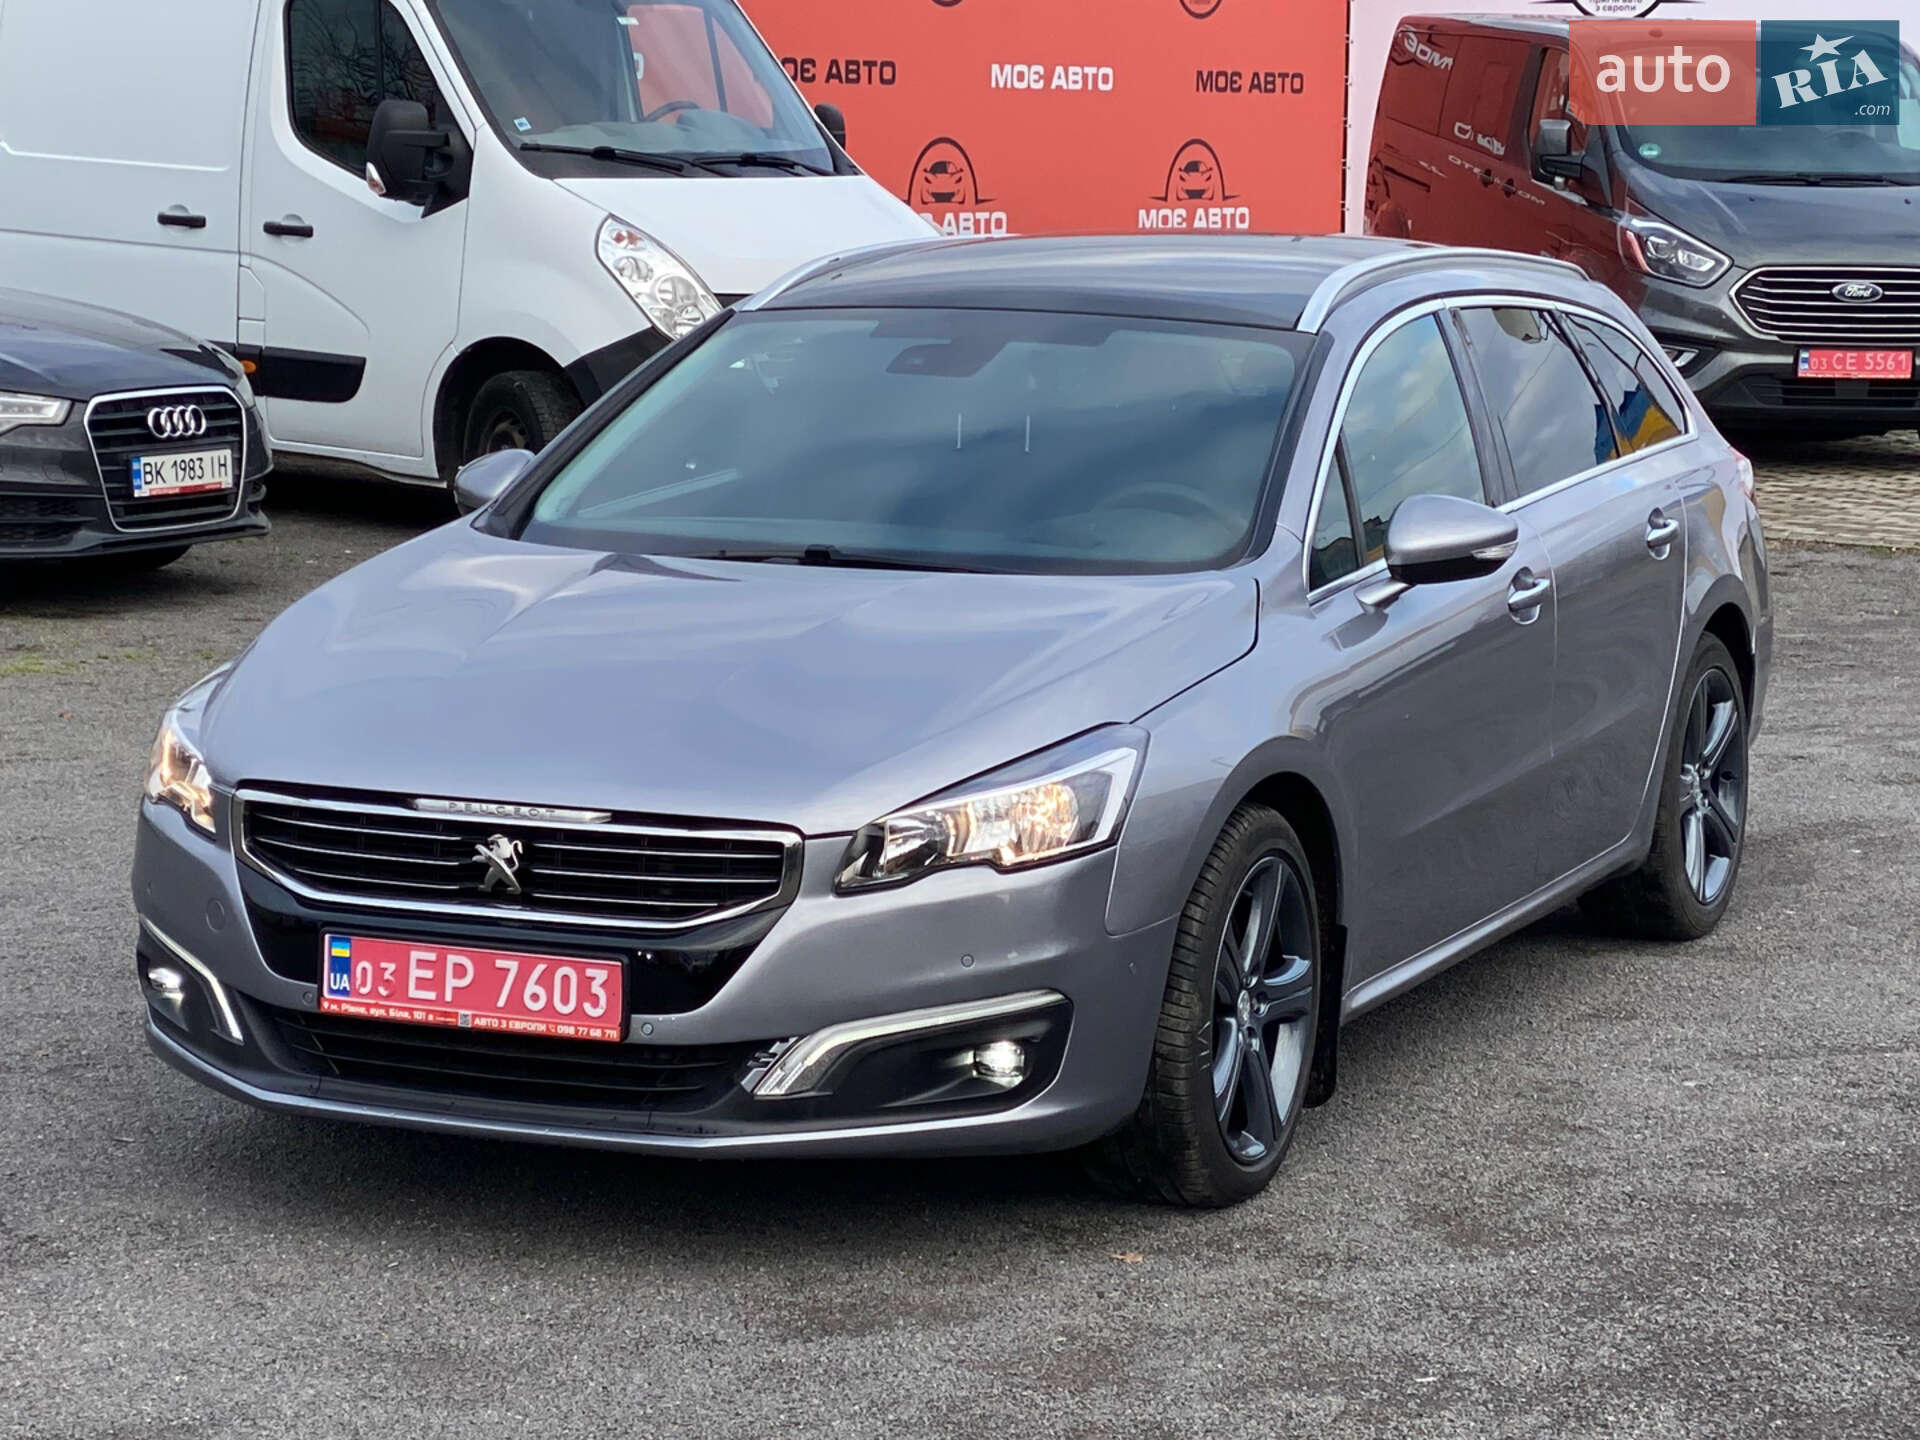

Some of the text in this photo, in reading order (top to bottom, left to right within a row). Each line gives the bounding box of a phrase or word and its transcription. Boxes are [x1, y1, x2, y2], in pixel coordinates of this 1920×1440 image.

[780, 57, 897, 85] ОЄ АВТО
[990, 63, 1114, 91] МОЄ АВТО
[1196, 70, 1304, 95] МОЄ АВТО
[942, 211, 1008, 237] АВТО
[1138, 206, 1250, 229] МОЄ АВТО
[1844, 284, 1873, 298] Ford
[1810, 352, 1907, 371] 03 CE 5561
[143, 454, 228, 485] BK 1983 IH
[448, 802, 556, 818] PEUGEOT
[330, 972, 351, 991] UA
[355, 949, 610, 1018] 03 EP 7603
